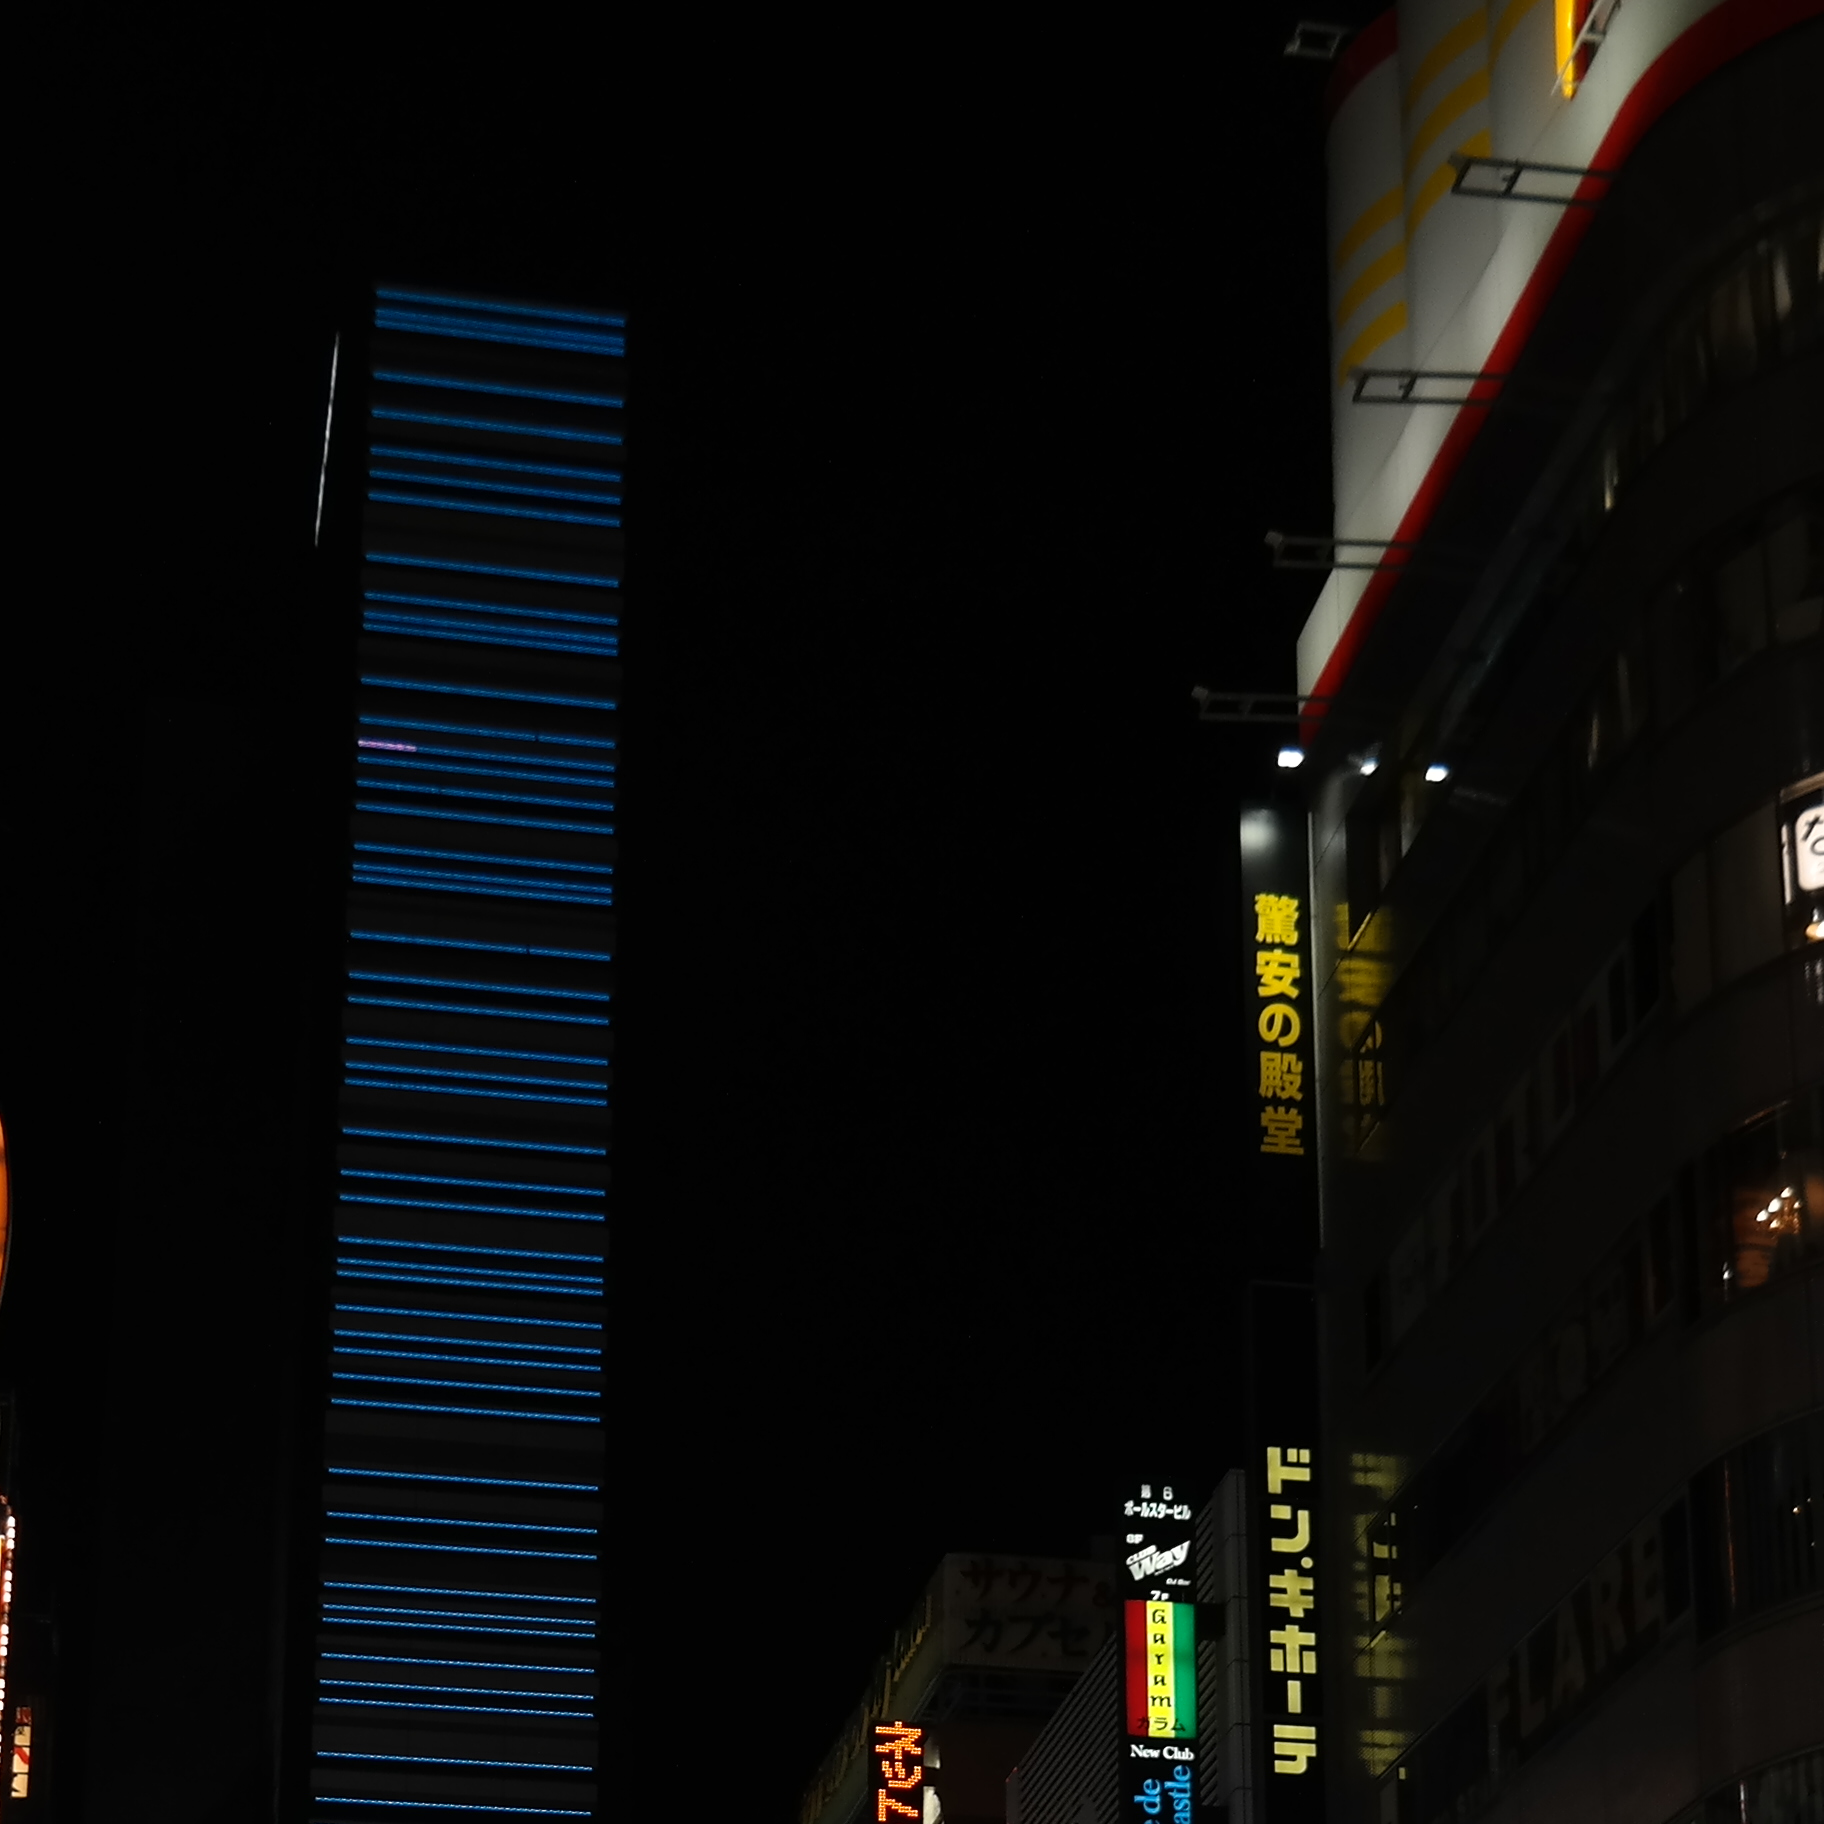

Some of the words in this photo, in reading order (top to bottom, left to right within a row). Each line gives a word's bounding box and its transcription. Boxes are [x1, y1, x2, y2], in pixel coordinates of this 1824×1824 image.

[1252, 893, 1304, 1156] 驚安の殿堂
[1127, 1541, 1191, 1581] Way
[1151, 1608, 1172, 1707] Garam
[1484, 1537, 1664, 1738] FLARE
[1130, 1744, 1160, 1760] New
[1162, 1746, 1195, 1760] Club
[1135, 1778, 1161, 1814] de
